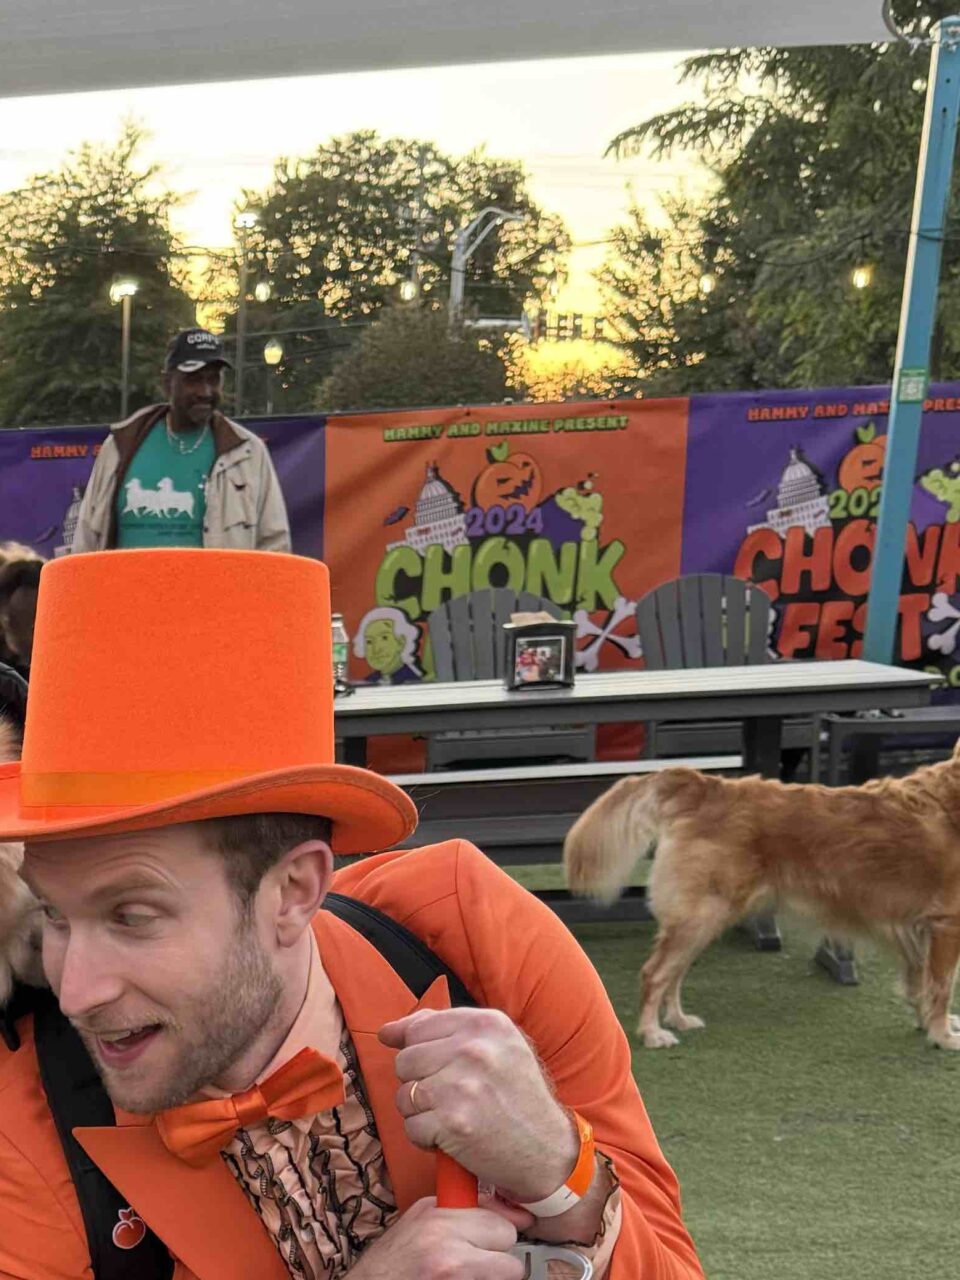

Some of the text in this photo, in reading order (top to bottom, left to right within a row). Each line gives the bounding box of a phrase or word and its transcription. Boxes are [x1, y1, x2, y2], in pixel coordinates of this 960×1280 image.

[747, 405, 808, 421] HAMMY
[814, 404, 848, 419] AND
[853, 401, 889, 416] MAX
[384, 415, 628, 441] HAMMY AND MAXINE PRESENT
[31, 444, 88, 459] HAMMY
[467, 503, 543, 536] 2024
[375, 536, 626, 619] CHONK
